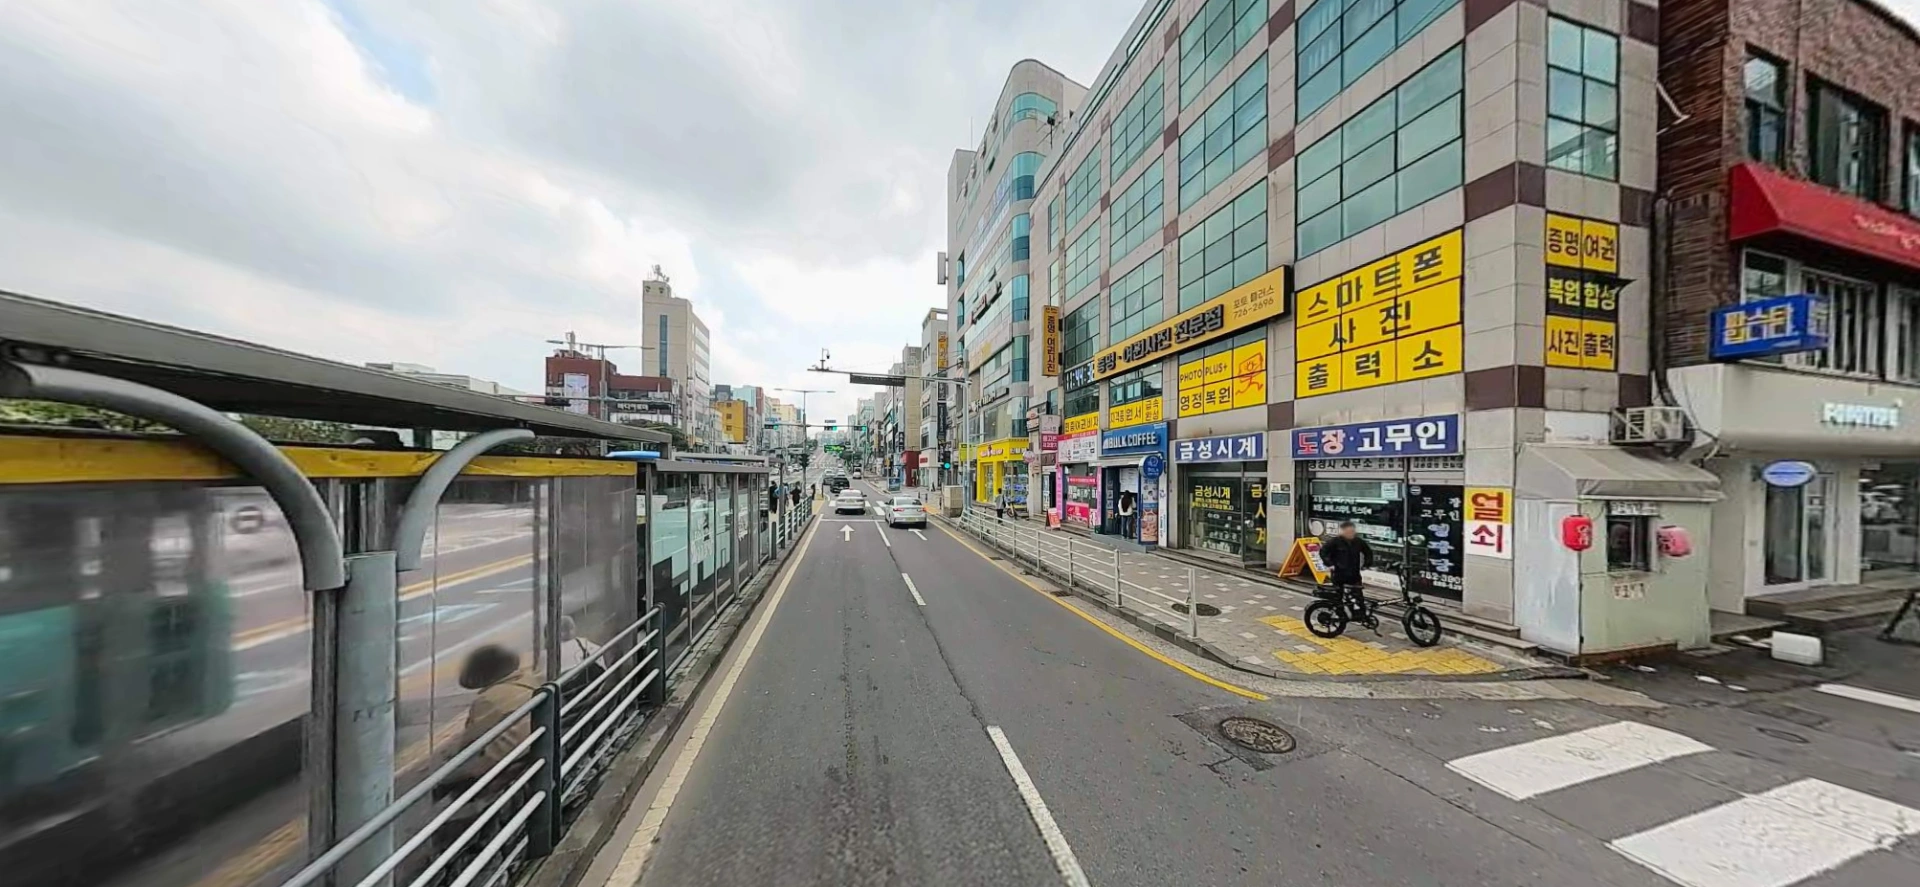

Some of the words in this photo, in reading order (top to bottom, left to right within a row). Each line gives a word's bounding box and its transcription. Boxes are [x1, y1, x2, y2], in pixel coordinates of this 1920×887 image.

[1548, 227, 1579, 257] 증명
[1584, 233, 1616, 262] 여권
[1306, 245, 1443, 318] 스마트폰
[1548, 277, 1581, 308] 복원
[1233, 297, 1274, 320] 726-2696
[1329, 300, 1412, 348] 사진
[1549, 329, 1580, 356] 사진
[1583, 332, 1614, 359] 출력
[1180, 371, 1203, 384] PHOTO
[1205, 365, 1228, 377] PLUS+
[1307, 340, 1444, 390] 출력소
[1127, 431, 1157, 447] COFFEE
[1179, 436, 1256, 459] 금성시계
[1298, 421, 1446, 455] 도장·고무인
[1195, 485, 1231, 499] 금성시계
[1470, 491, 1504, 553] 열쇠
